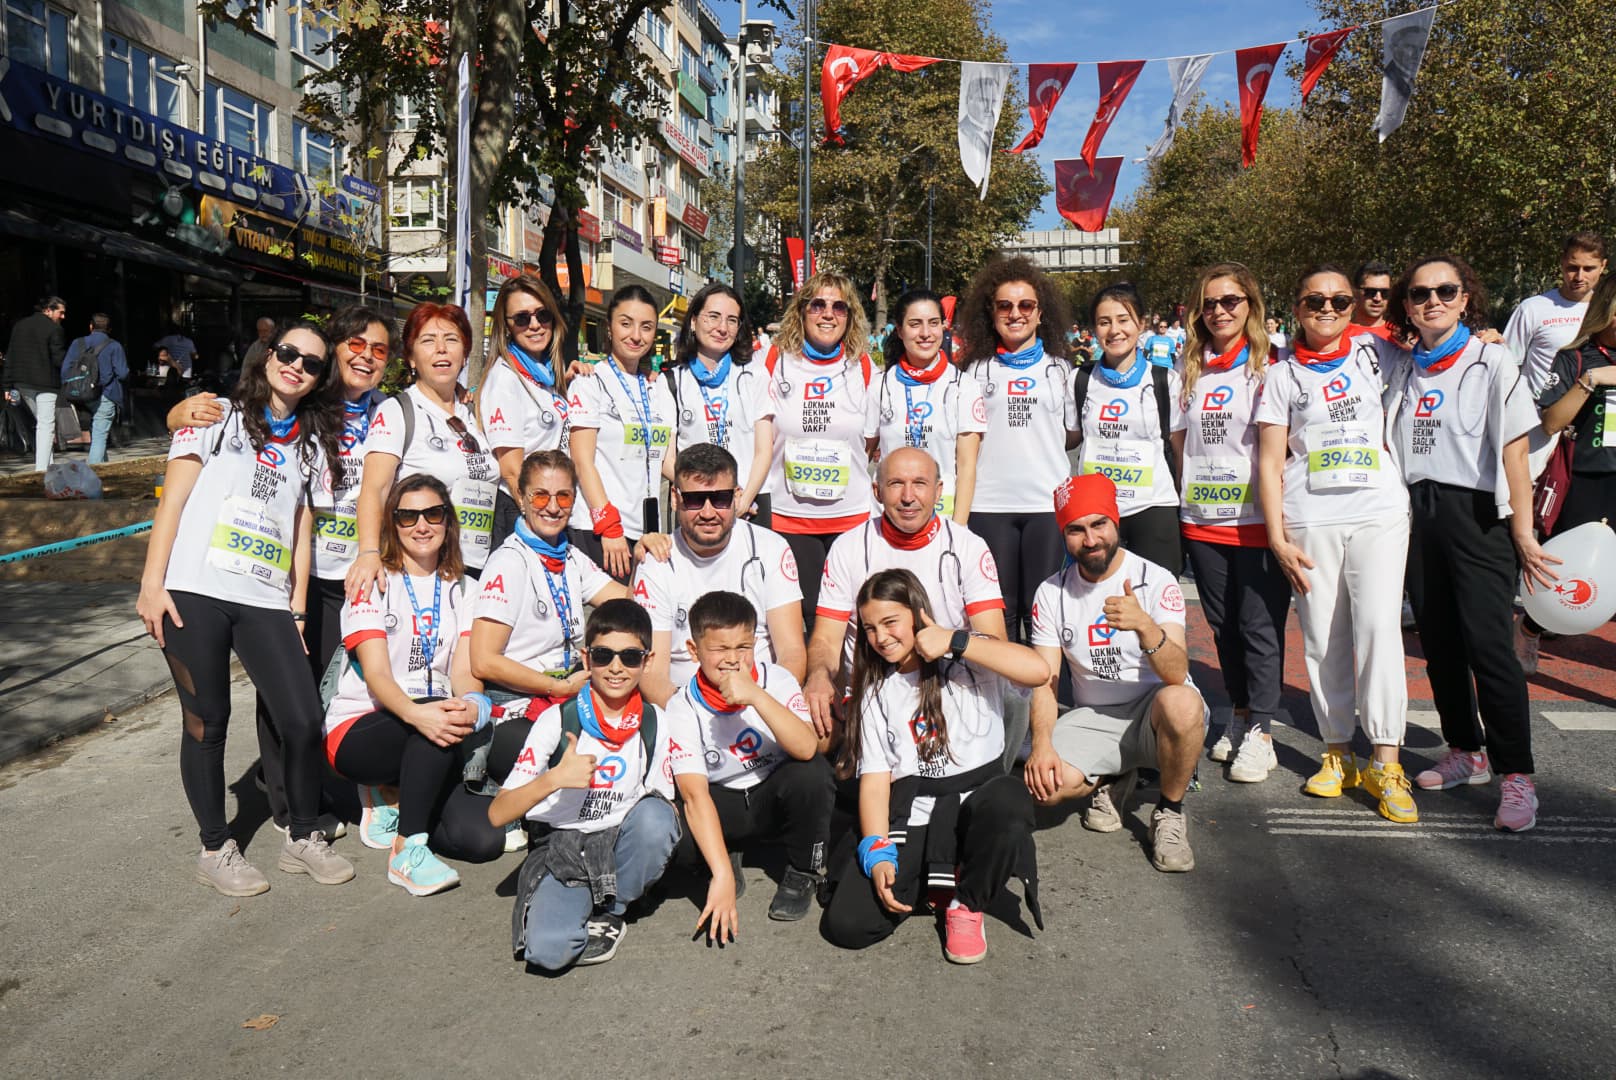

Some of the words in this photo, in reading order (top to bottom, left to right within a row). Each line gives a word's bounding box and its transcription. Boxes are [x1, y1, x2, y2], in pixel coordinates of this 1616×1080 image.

[45, 81, 186, 159] YURTDIŞI
[196, 140, 273, 189] EĞİTİM
[803, 401, 836, 409] LOKMAN
[1008, 397, 1038, 405] LOKMAN
[1327, 394, 1361, 412] LOKMAN
[1201, 412, 1232, 421] LOKMAN
[1008, 419, 1028, 427] VAKFI
[1098, 422, 1129, 432] LOKMAN
[1413, 419, 1441, 428] LOKMAN
[802, 424, 827, 433] VAKFI
[631, 427, 667, 443] 3906
[1203, 436, 1224, 445] VAKFI
[1412, 446, 1431, 455] VAKFI
[1320, 450, 1373, 467] 39426
[793, 466, 840, 482] 39392
[1192, 486, 1242, 501] 39409
[459, 510, 492, 529] 39371
[227, 531, 282, 564] 39381
[1089, 647, 1122, 657] LOKMAN
[586, 790, 623, 803] LOKMAN
